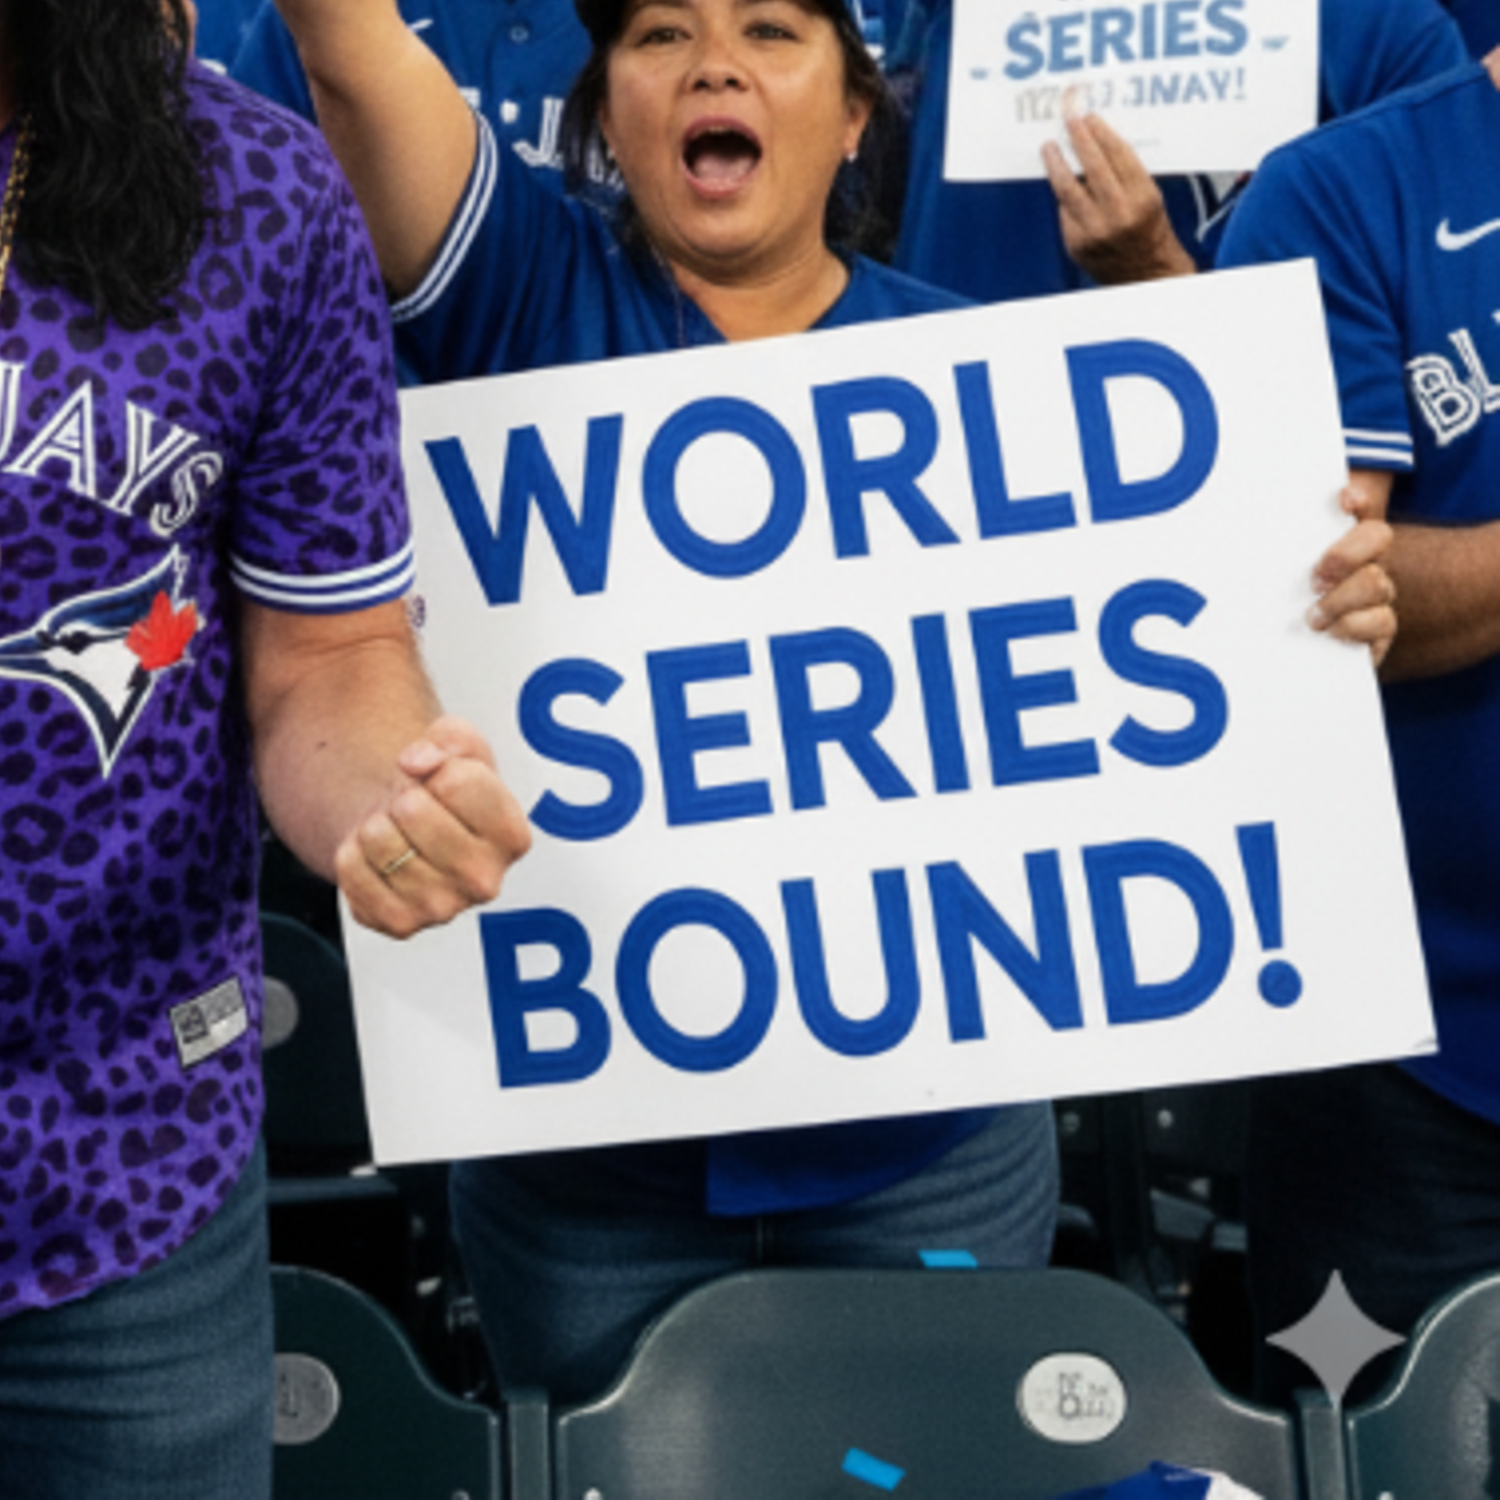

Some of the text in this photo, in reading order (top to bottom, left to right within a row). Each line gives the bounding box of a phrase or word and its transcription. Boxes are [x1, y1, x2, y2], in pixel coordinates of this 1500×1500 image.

[423, 337, 1220, 608] WORLD
[514, 577, 1231, 843] SERIES
[476, 819, 1304, 1090] BOUND!
